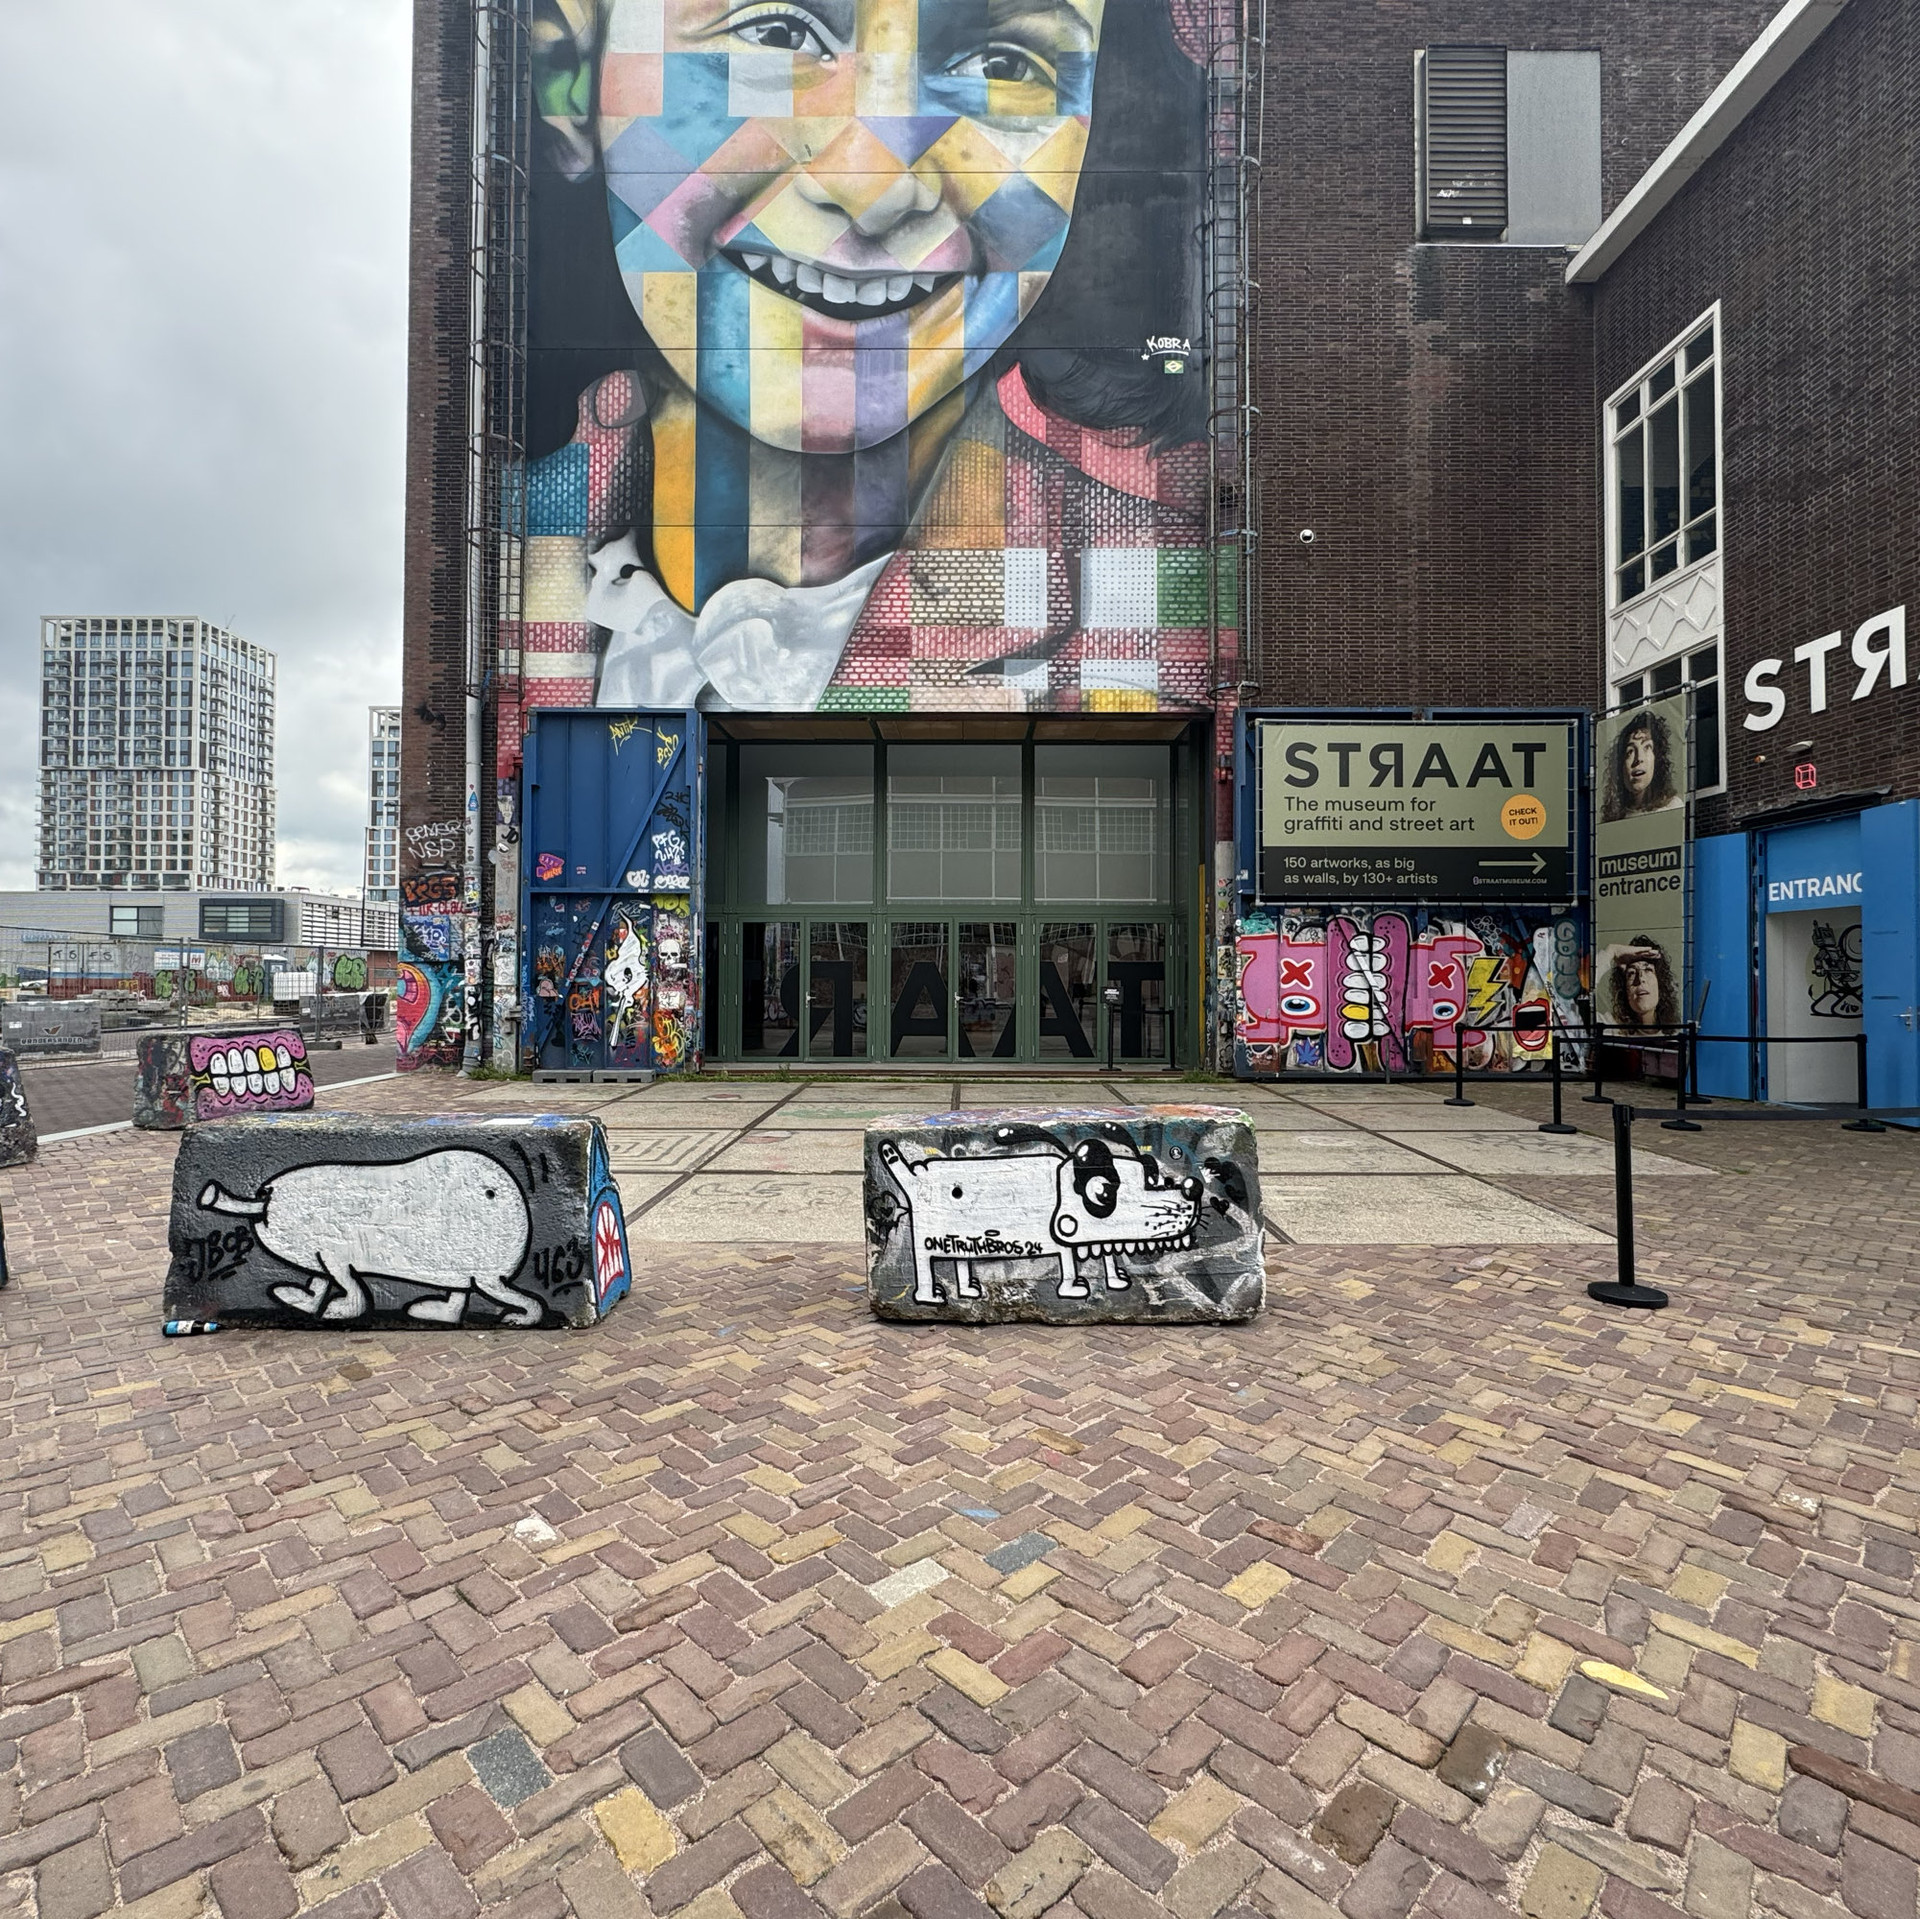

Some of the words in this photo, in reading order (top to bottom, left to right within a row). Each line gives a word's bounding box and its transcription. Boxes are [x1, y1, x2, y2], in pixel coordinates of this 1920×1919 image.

[1146, 335, 1191, 352] KOBRA
[1743, 604, 1920, 732] STR
[1284, 797, 1318, 811] The
[1325, 800, 1404, 811] museum
[1410, 797, 1436, 811] for
[1508, 807, 1537, 816] CHECK
[1284, 816, 1343, 834] graffiti
[1349, 817, 1382, 831] and
[1389, 818, 1443, 831] street
[1450, 818, 1475, 831] art
[1518, 817, 1538, 825] OUT!
[1283, 857, 1306, 868] 150
[1310, 857, 1371, 870] artworks,
[1375, 859, 1390, 868] as
[1394, 857, 1415, 871] big
[1601, 850, 1678, 874] museum
[1284, 875, 1299, 884] as
[1303, 872, 1339, 886] walls,
[1343, 872, 1358, 887] by
[1362, 872, 1392, 884] 130+
[1396, 873, 1438, 884] artists
[1599, 875, 1680, 897] entrance
[1768, 872, 1862, 901] ENTRANC
[924, 1233, 1024, 1256] ONETRUTHBROS
[1025, 1240, 1043, 1256] 24
